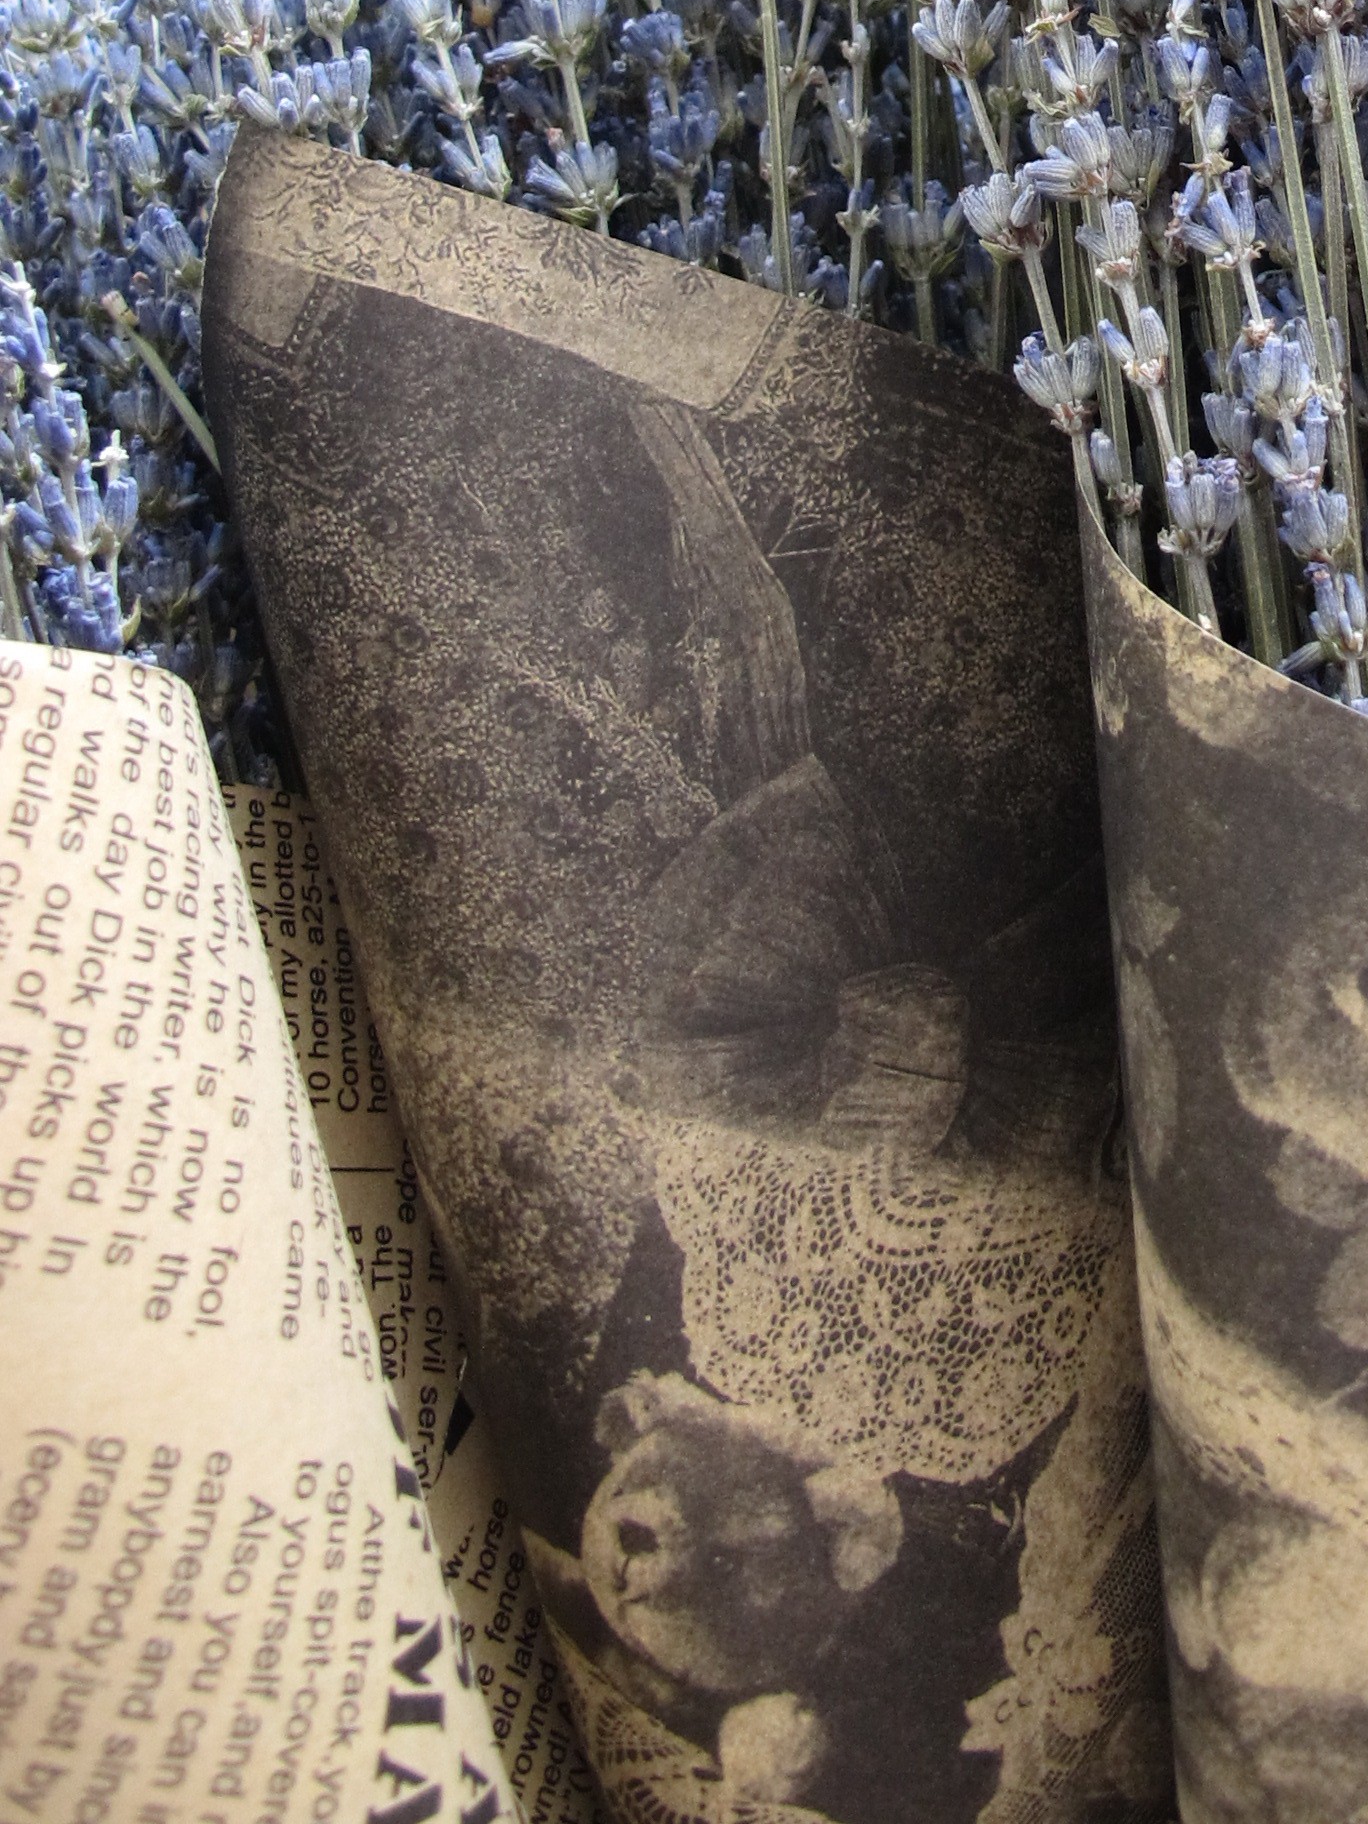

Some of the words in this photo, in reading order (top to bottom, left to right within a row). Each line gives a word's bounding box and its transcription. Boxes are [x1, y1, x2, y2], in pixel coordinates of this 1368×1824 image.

[130, 664, 149, 711] of
[7, 686, 67, 849] regular
[60, 730, 104, 852] walks
[121, 717, 150, 782] the
[154, 741, 178, 835] best
[94, 812, 138, 894] day
[177, 790, 205, 919] racing
[246, 799, 265, 857] the
[142, 838, 173, 910] job
[251, 865, 266, 888] in
[274, 820, 296, 938] allotted
[28, 883, 72, 955] out
[70, 910, 123, 1006] Dick
[133, 927, 164, 962] in
[206, 883, 230, 968] why
[11, 970, 46, 1019] of
[153, 935, 195, 1063] writer,
[206, 981, 230, 1034] he
[281, 949, 302, 997] my
[307, 958, 328, 1058] horse,
[113, 981, 153, 1049] the
[237, 975, 257, 1065] Dick
[335, 927, 360, 1112] Convention
[26, 1020, 88, 1139] picks
[196, 1063, 224, 1097] is
[231, 1096, 255, 1128] is
[308, 1071, 331, 1109] 10
[0, 1156, 46, 1211] up
[67, 1081, 127, 1204] world
[120, 1084, 174, 1213] which
[172, 1129, 208, 1222] now
[219, 1159, 243, 1213] no
[104, 1230, 146, 1266] is
[144, 1252, 189, 1321] the
[281, 1220, 304, 1340] came
[371, 1225, 394, 1290] The
[186, 1245, 239, 1338] fool,
[339, 1280, 357, 1360] and
[422, 1304, 448, 1374] civil
[58, 1435, 126, 1552] gram
[295, 1459, 322, 1500] to
[323, 1462, 355, 1571] ogus
[156, 1450, 233, 1623] earnest
[224, 1495, 277, 1596] Also
[467, 1497, 510, 1594] horse
[21, 1564, 78, 1650] and
[483, 1551, 526, 1644] fence
[117, 1637, 175, 1722] and
[189, 1612, 242, 1693] you
[505, 1606, 541, 1678] lake
[153, 1709, 207, 1790] can
[510, 1659, 559, 1800] rowned
